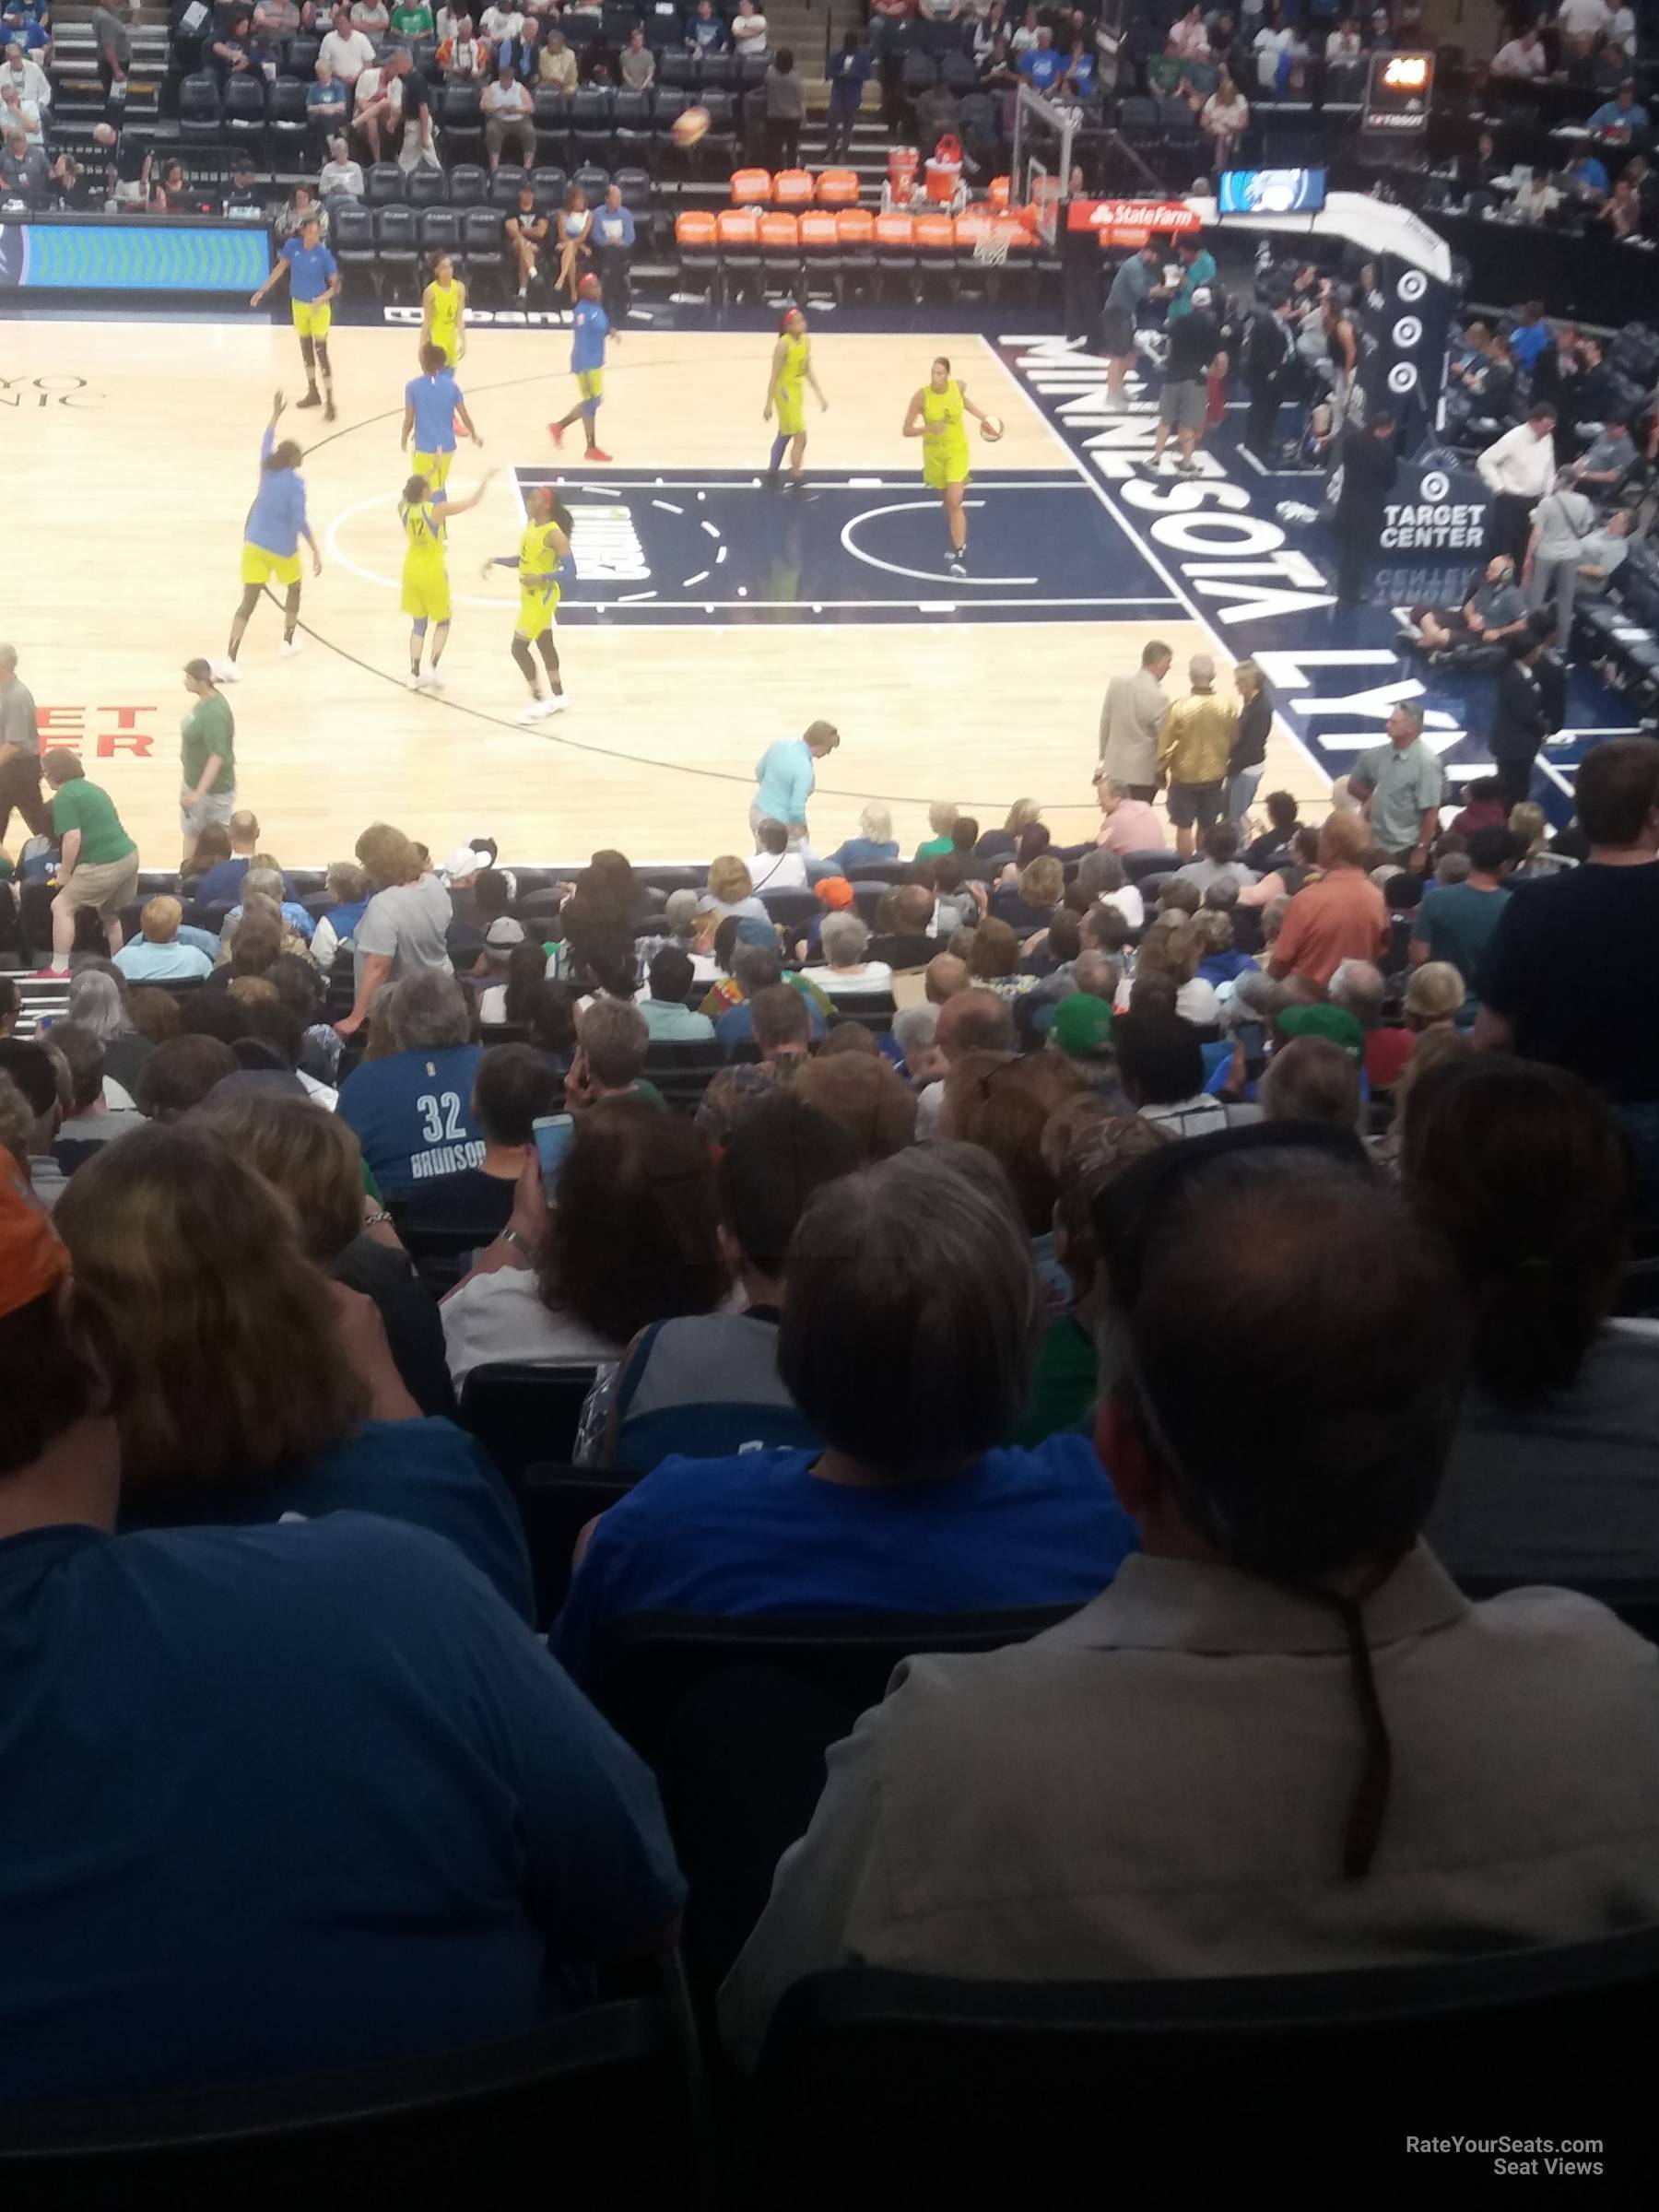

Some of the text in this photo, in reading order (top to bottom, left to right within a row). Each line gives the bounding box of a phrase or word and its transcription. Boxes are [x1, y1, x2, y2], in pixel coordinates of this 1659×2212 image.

[1383, 504, 1487, 526] TARGET
[1380, 526, 1485, 548] CENTER
[417, 1091, 466, 1142] 32
